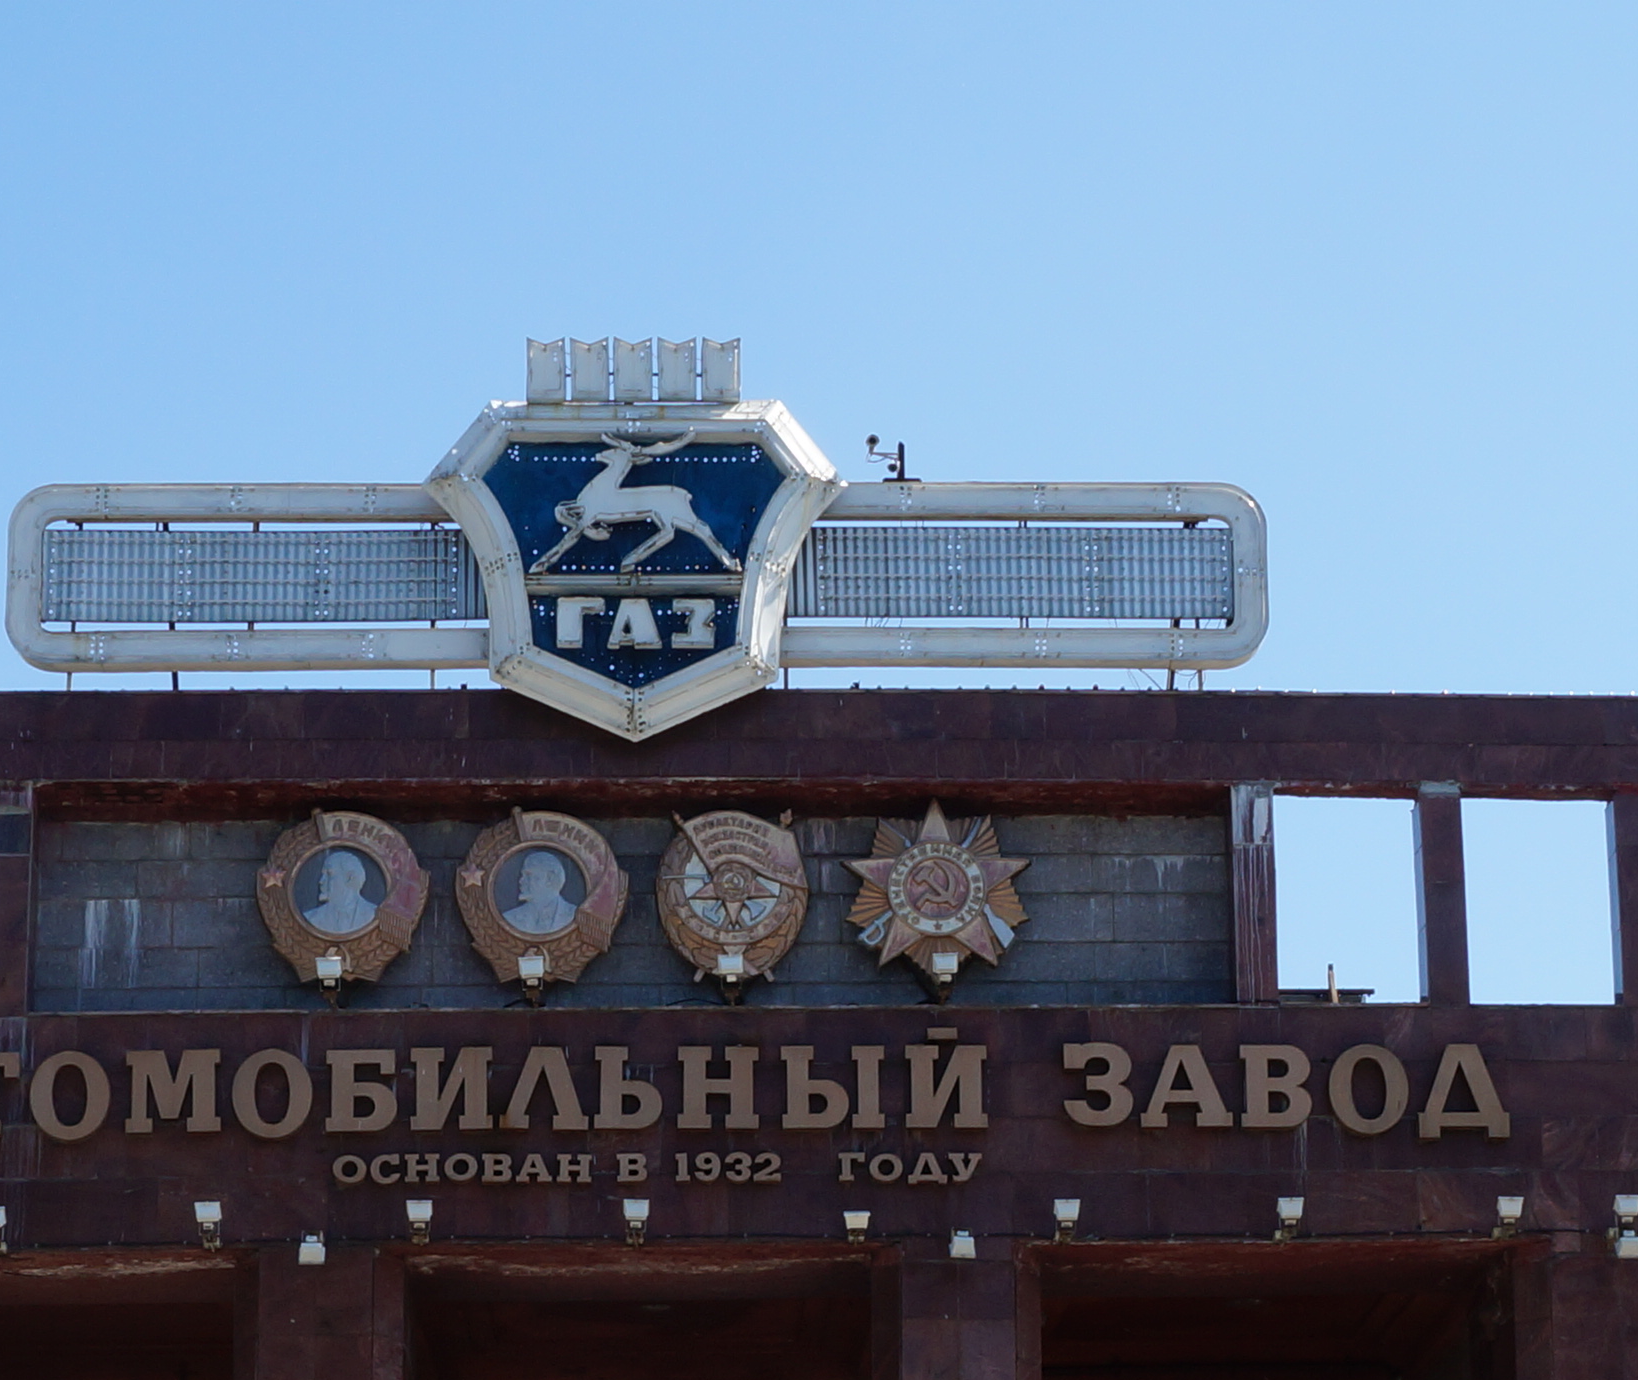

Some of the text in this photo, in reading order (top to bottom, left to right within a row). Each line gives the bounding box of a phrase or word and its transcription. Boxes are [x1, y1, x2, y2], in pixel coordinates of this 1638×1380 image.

[557, 597, 716, 650] ГАЗ
[1060, 1042, 1512, 1140] ЗАВОД
[332, 1151, 985, 1185] ОСНОВАН В 1932 ГОДУ
